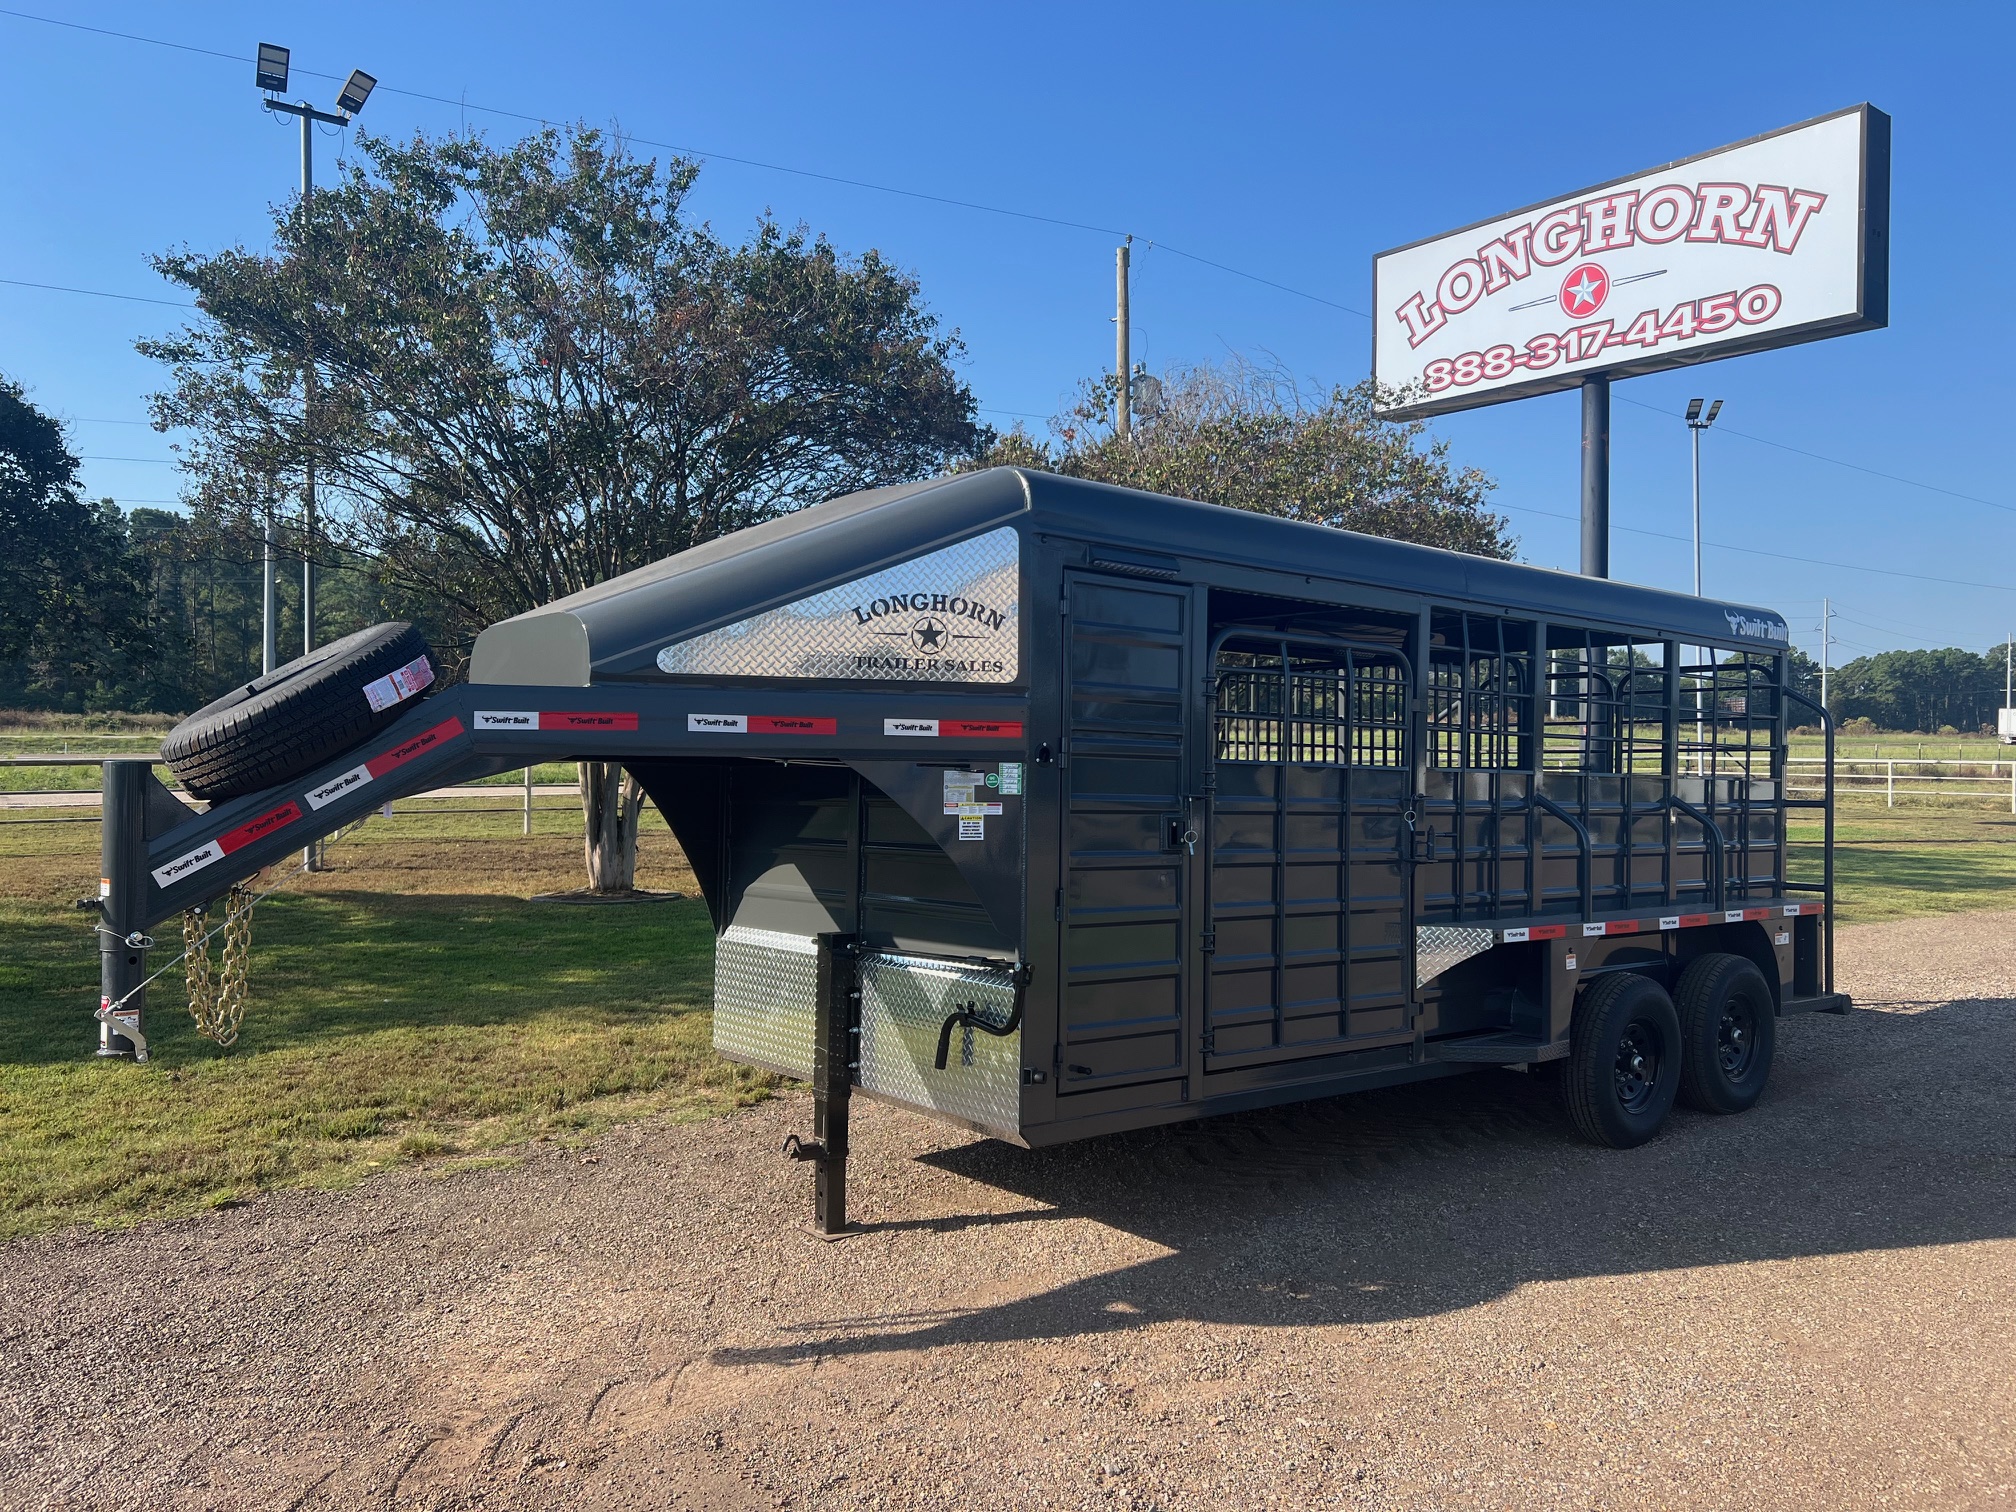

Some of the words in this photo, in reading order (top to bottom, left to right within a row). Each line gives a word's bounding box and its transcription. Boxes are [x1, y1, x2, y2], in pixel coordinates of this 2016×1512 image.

[1396, 182, 1828, 350] LONGHORN
[1423, 284, 1781, 392] 888-317-4450
[852, 593, 1006, 631] LONGHORN
[1740, 616, 1768, 639] Swift
[1767, 620, 1788, 641] Built
[853, 656, 939, 670] TRAILER
[944, 659, 1003, 673] SALES
[491, 716, 513, 724] Swift
[702, 718, 723, 727] Swift
[401, 741, 421, 756] Swift
[324, 781, 344, 797] Swift
[343, 773, 361, 786] Built
[173, 859, 194, 874] Swift
[194, 850, 212, 863] Built
